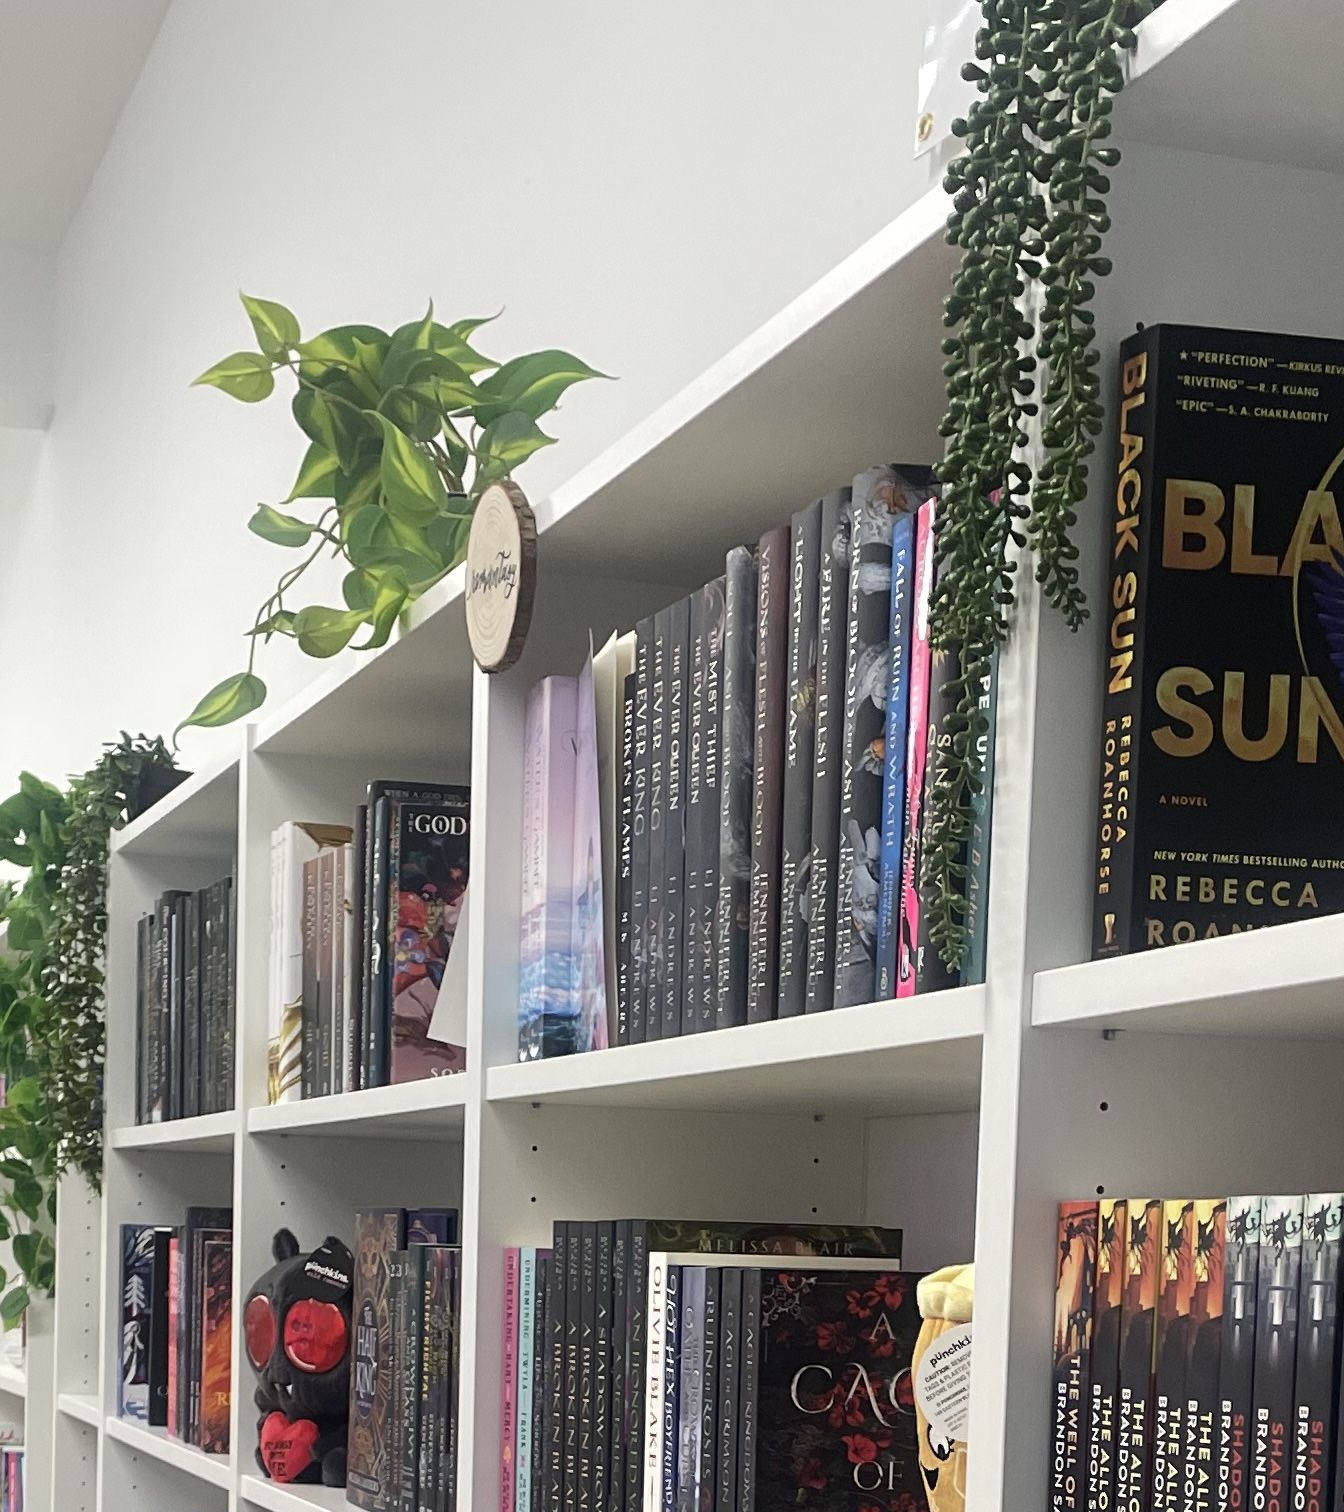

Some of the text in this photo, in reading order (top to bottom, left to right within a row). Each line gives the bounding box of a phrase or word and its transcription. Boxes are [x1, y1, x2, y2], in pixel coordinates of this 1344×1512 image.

[1253, 406, 1329, 423] CHAKRABORTY
[1282, 385, 1320, 398] KUANG
[1108, 351, 1148, 696] BLACK SUN
[890, 548, 906, 606] FALL
[707, 660, 718, 714] MIST
[890, 645, 903, 703] RUIN
[706, 723, 717, 788] THIEF
[1115, 714, 1132, 843] REBECCA
[886, 755, 899, 848] WRATH
[1098, 719, 1117, 895] ROANHORSE
[1159, 794, 1209, 808] A NOVEL
[1153, 850, 1177, 862] NEW
[1180, 851, 1208, 863] YORK
[1212, 853, 1240, 865] TIMES
[1242, 855, 1308, 868] BESTSELLING
[1149, 873, 1319, 909] REBECCA
[698, 1239, 855, 1256] MELISSA BLAIR
[869, 1312, 897, 1341] A
[1070, 1355, 1081, 1401] THE
[662, 1345, 675, 1505] HEX BOYFRIEND
[1054, 1382, 1067, 1489] BRANDON
[1067, 1408, 1079, 1470] WELL
[1197, 1411, 1213, 1463] THE
[853, 1460, 905, 1491] OF
[1065, 1477, 1076, 1510] OF
